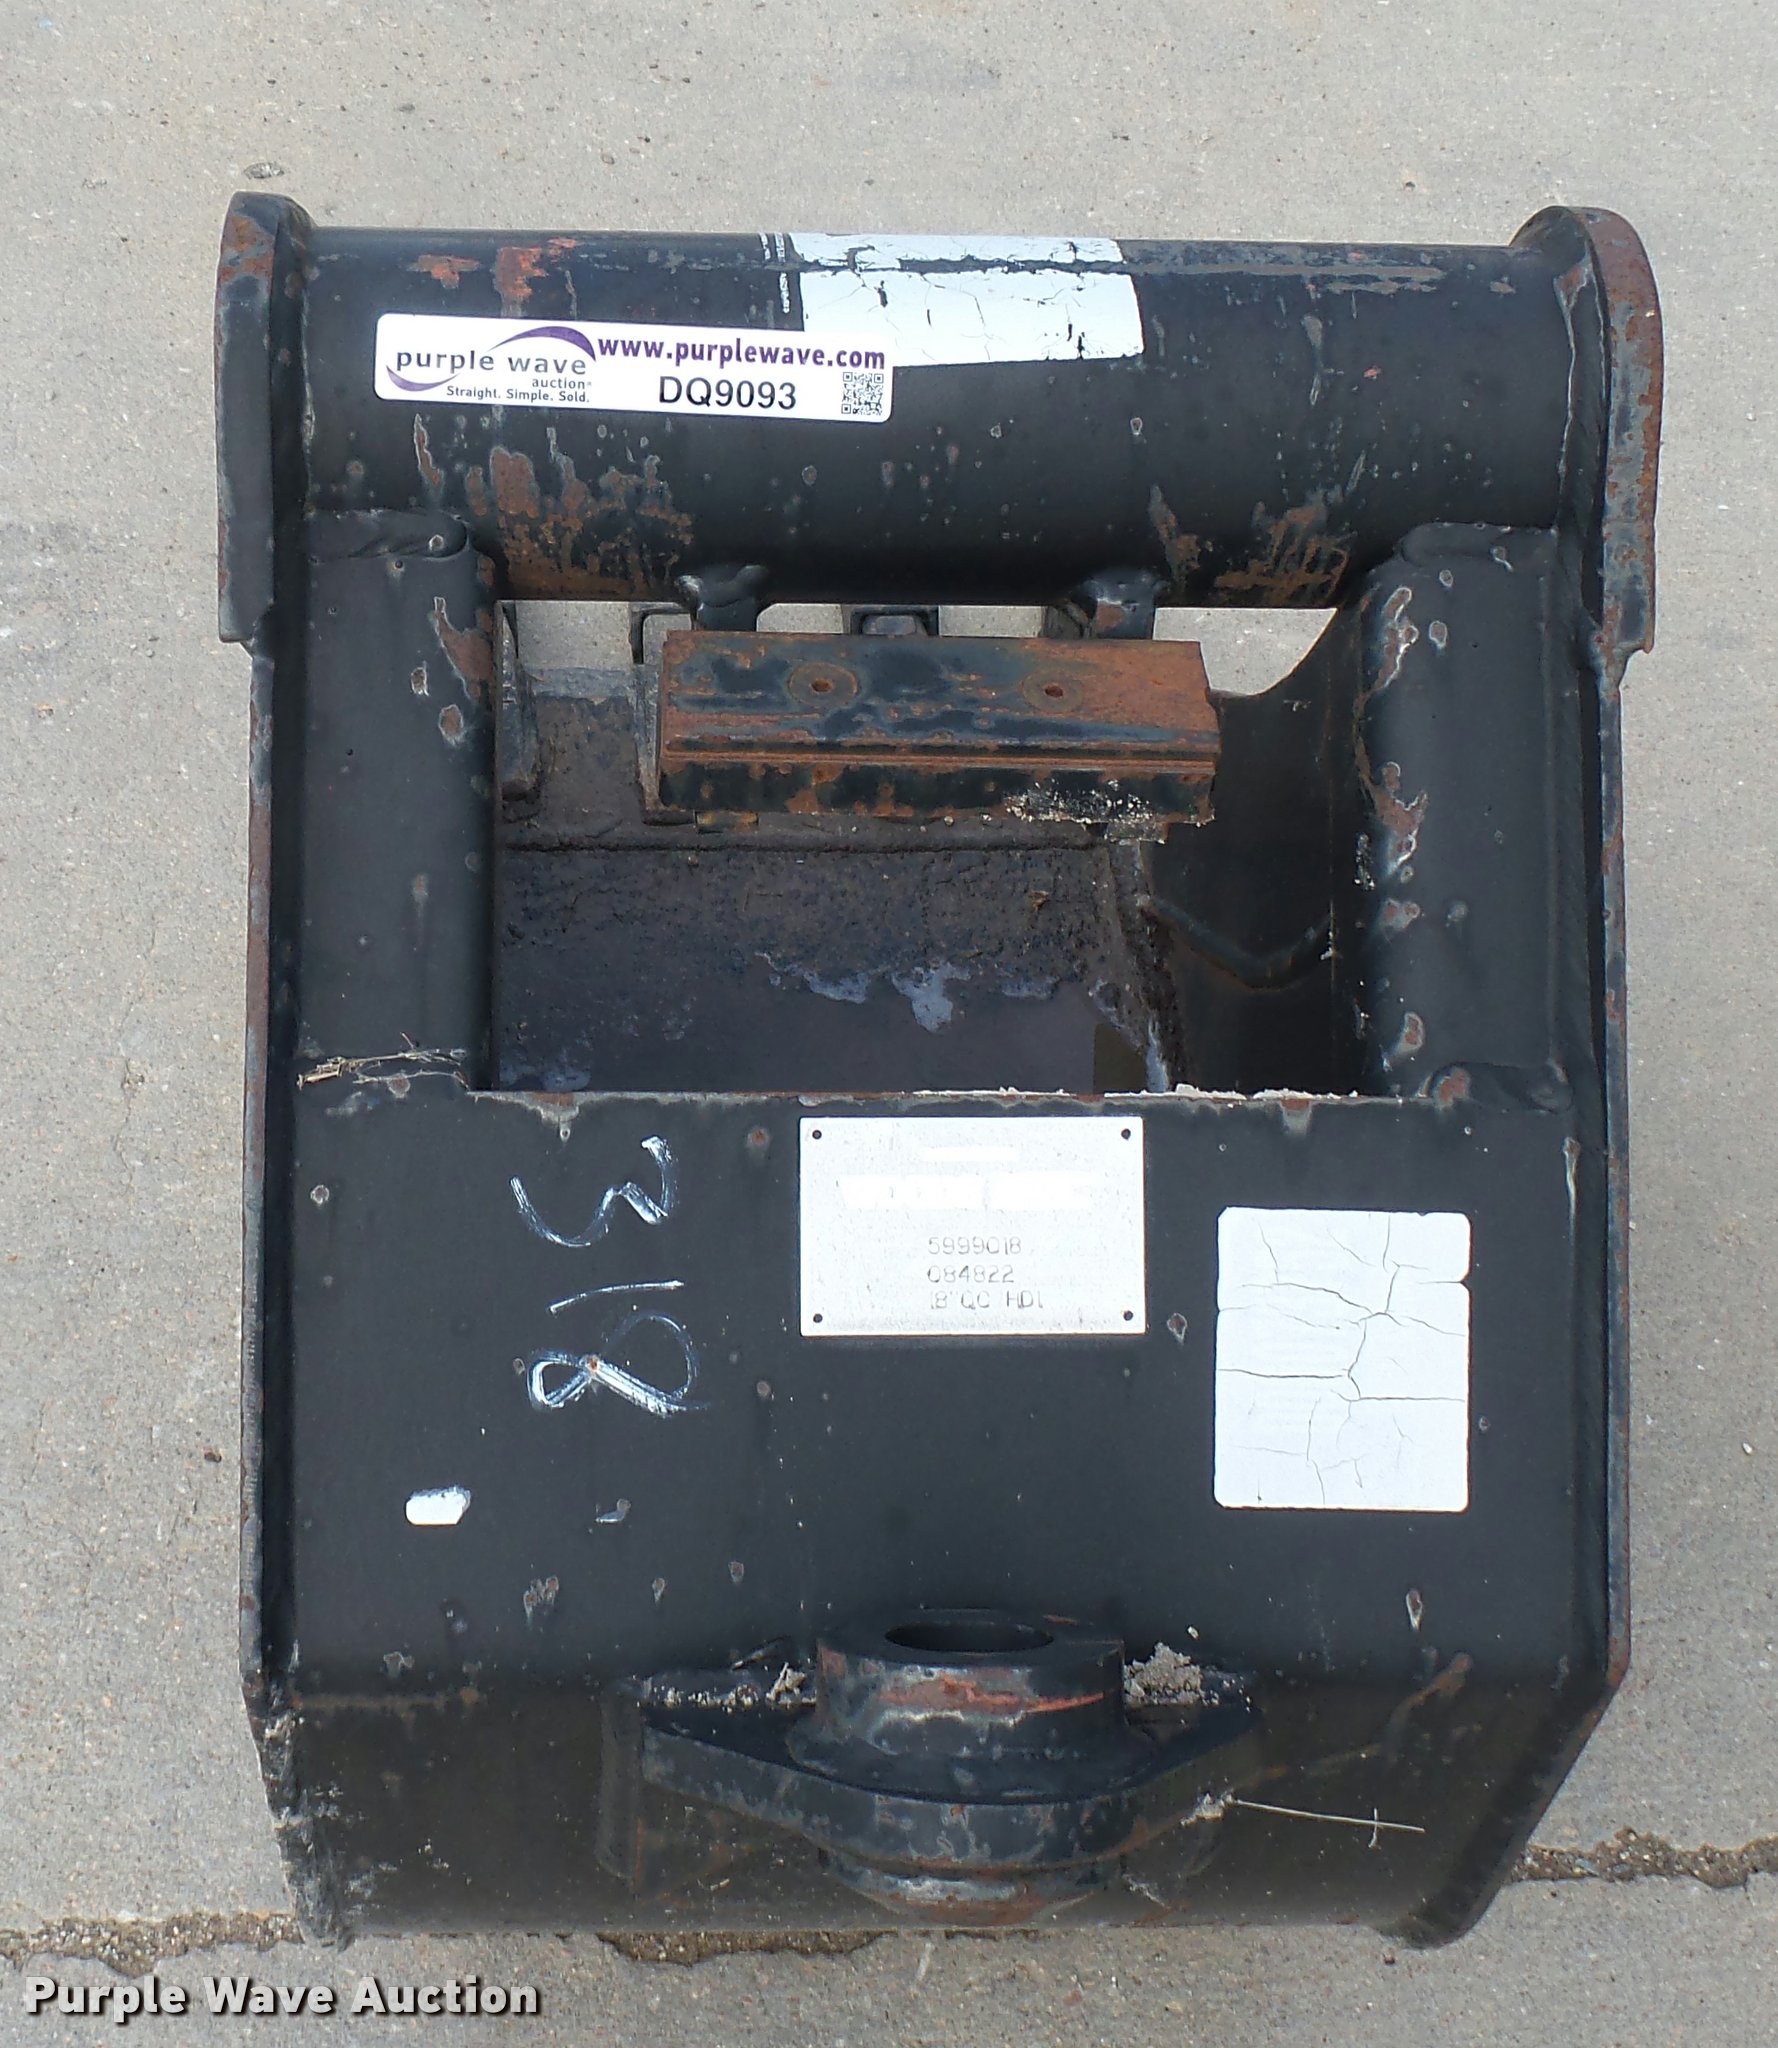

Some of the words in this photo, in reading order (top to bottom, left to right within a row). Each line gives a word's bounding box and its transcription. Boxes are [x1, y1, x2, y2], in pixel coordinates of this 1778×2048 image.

[396, 350, 495, 374] purple
[507, 356, 587, 375] wave
[598, 336, 885, 371] www.purplewave.com
[446, 385, 501, 401] Straight.
[506, 388, 554, 403] Simple.
[558, 389, 590, 403] Sold.
[658, 376, 797, 411] DQ9093
[927, 1236, 1022, 1256] 5999018
[926, 1264, 1015, 1284] 084822
